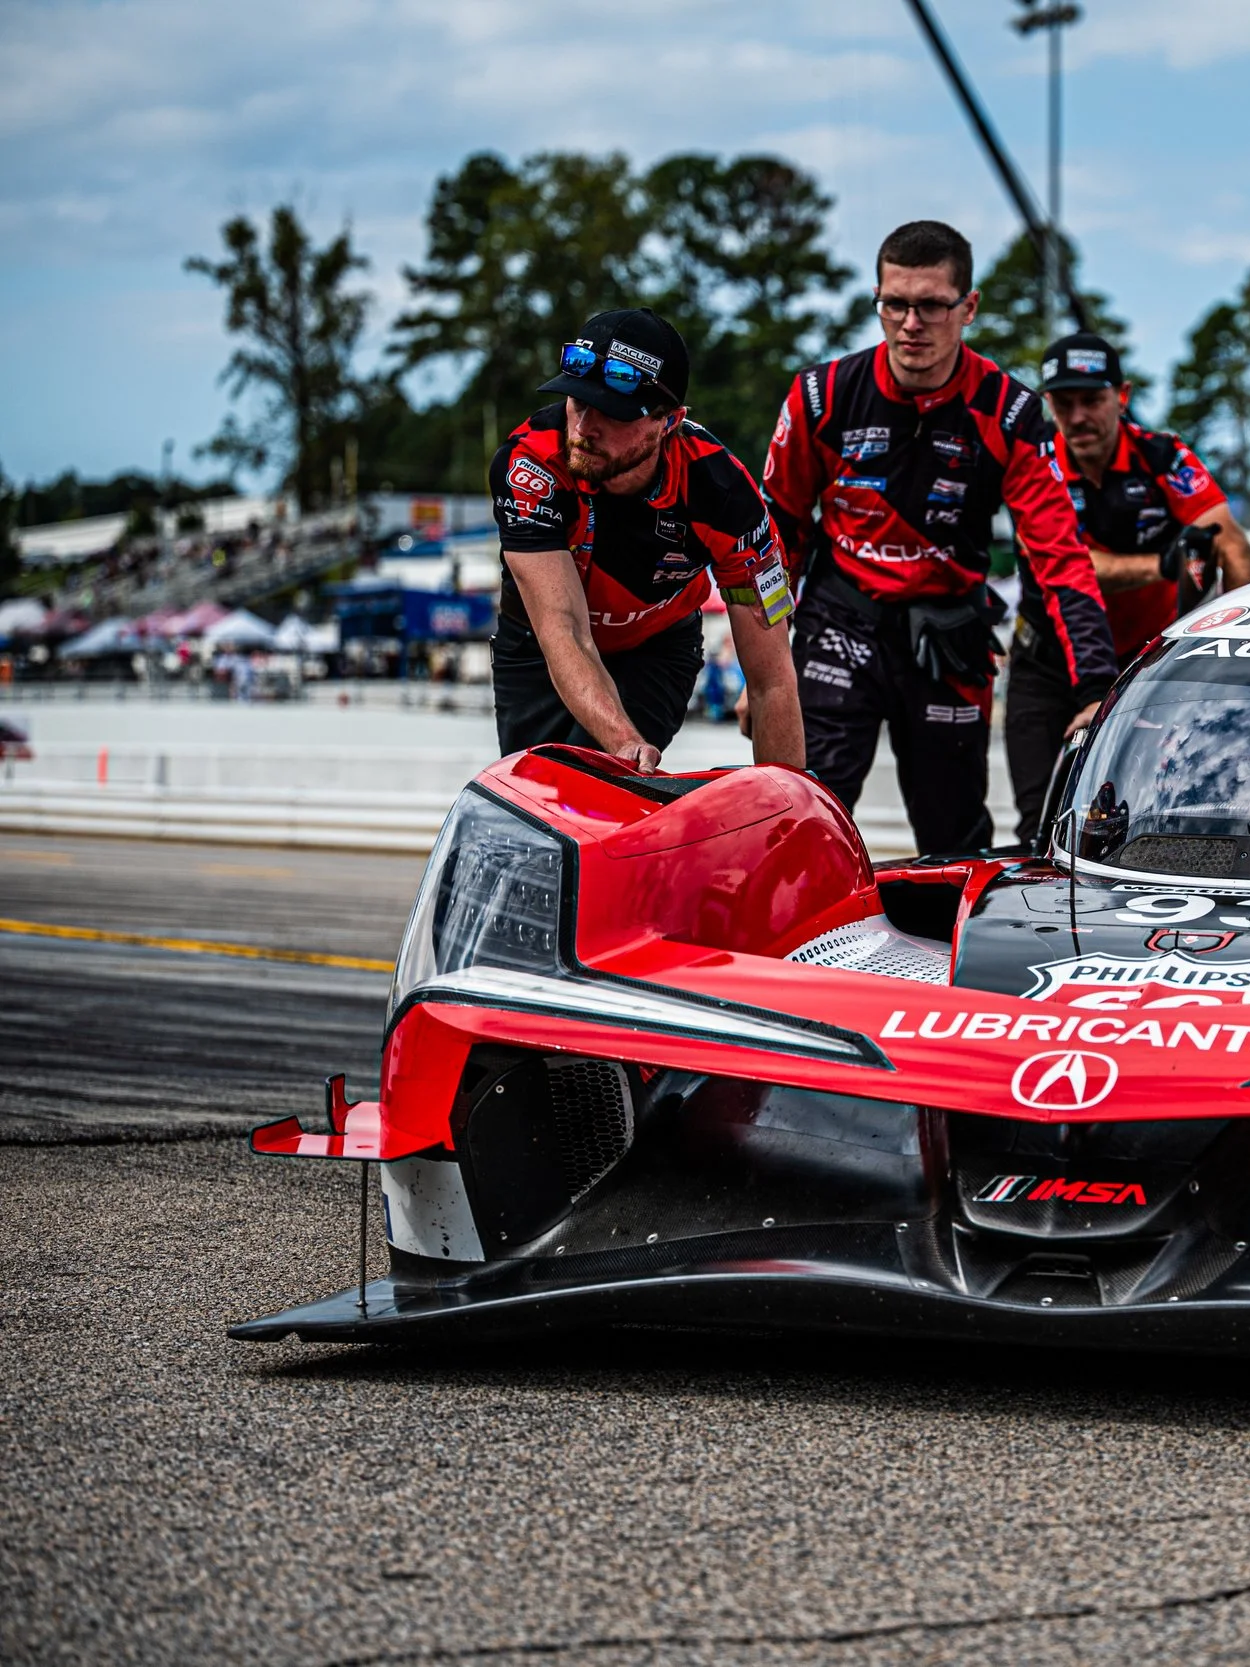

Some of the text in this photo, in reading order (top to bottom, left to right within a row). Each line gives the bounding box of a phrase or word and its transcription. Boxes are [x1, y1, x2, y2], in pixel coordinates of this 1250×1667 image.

[620, 347, 659, 369] ACURA
[515, 471, 545, 491] 66
[519, 460, 553, 482] PHILLIPS
[503, 498, 563, 522] ACURA
[760, 572, 783, 594] 60/93
[1028, 1177, 1148, 1206] IMSA
